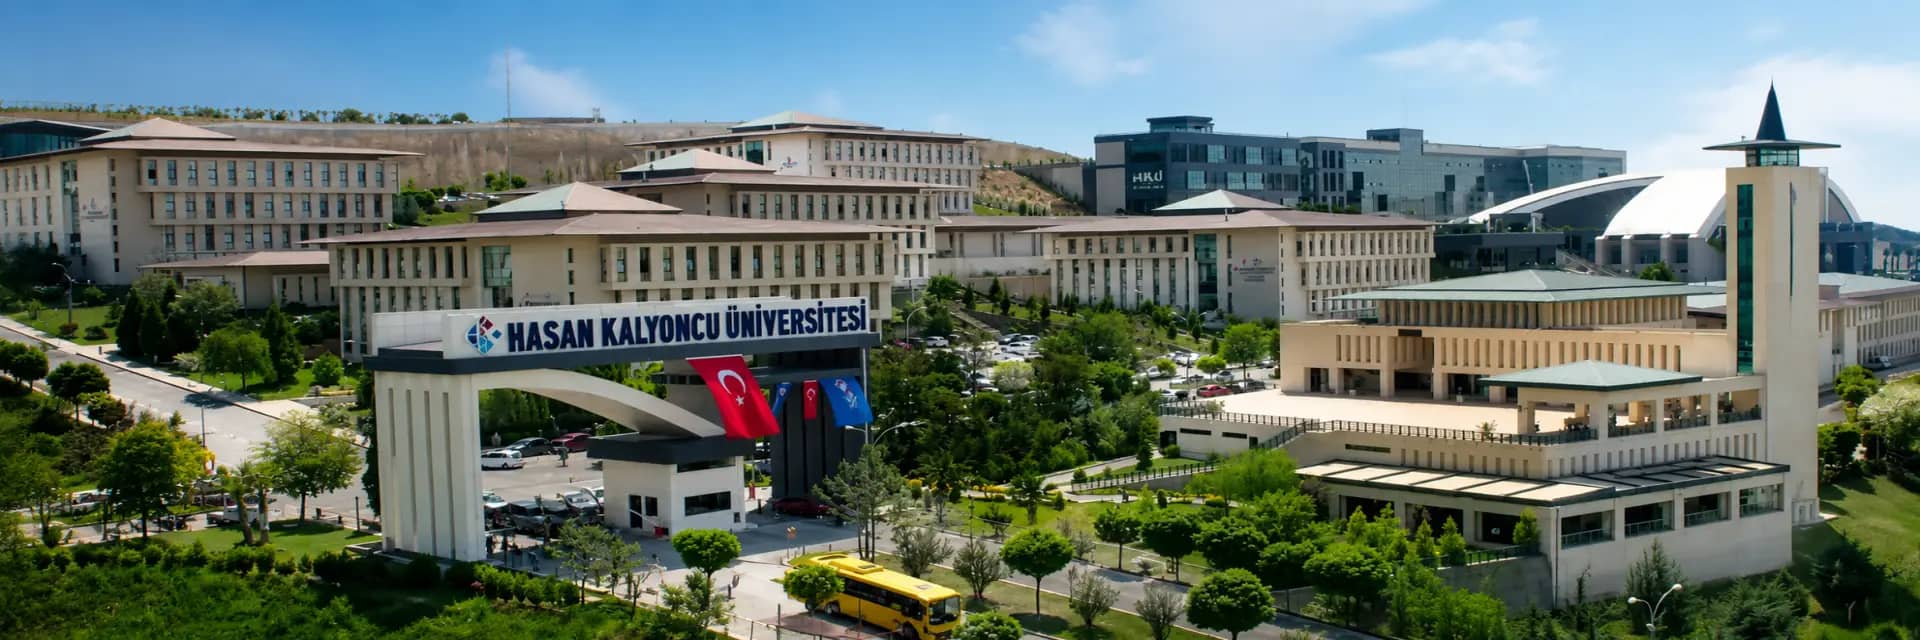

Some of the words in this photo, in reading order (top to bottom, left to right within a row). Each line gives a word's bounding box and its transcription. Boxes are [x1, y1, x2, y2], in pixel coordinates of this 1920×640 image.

[507, 318, 594, 353] HASAN
[602, 312, 720, 347] KALYONCU
[726, 299, 866, 339] ÜNİVERSİTESİ
